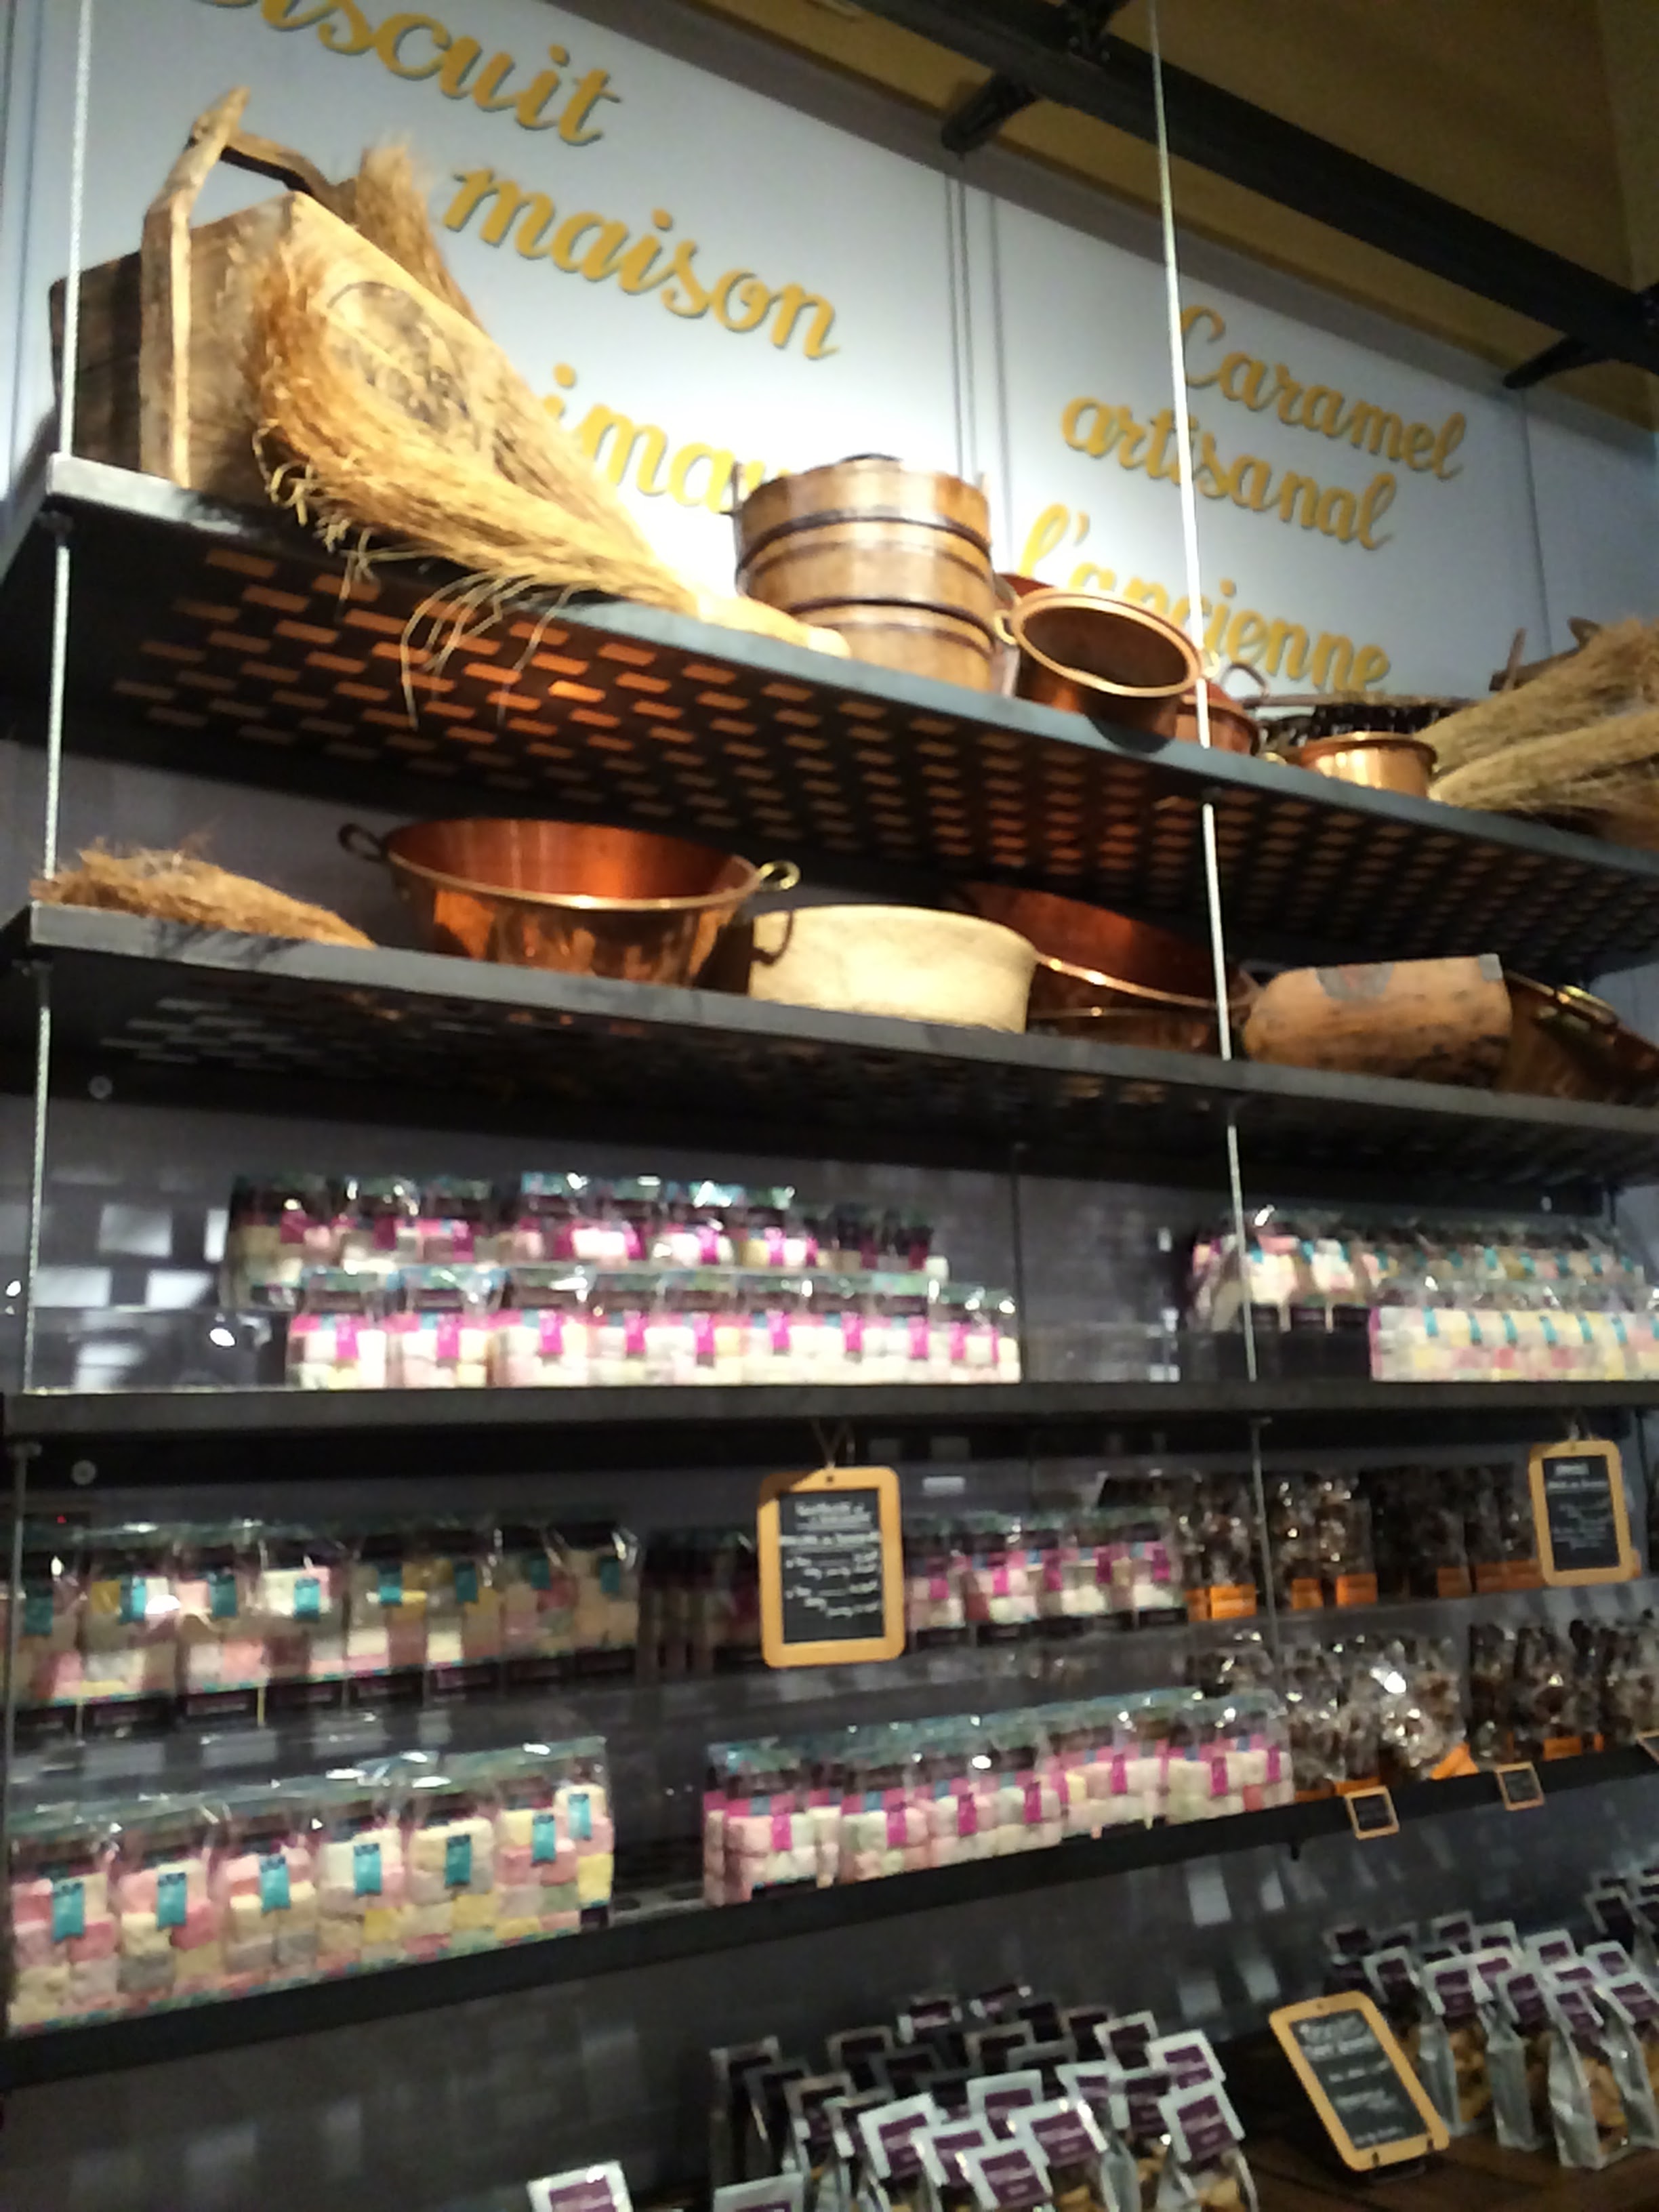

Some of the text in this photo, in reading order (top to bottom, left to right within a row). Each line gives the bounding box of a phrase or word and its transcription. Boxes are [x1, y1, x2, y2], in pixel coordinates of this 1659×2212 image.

[197, 0, 621, 145] scuit
[442, 165, 840, 361] maison
[1177, 304, 1467, 481] Caramel
